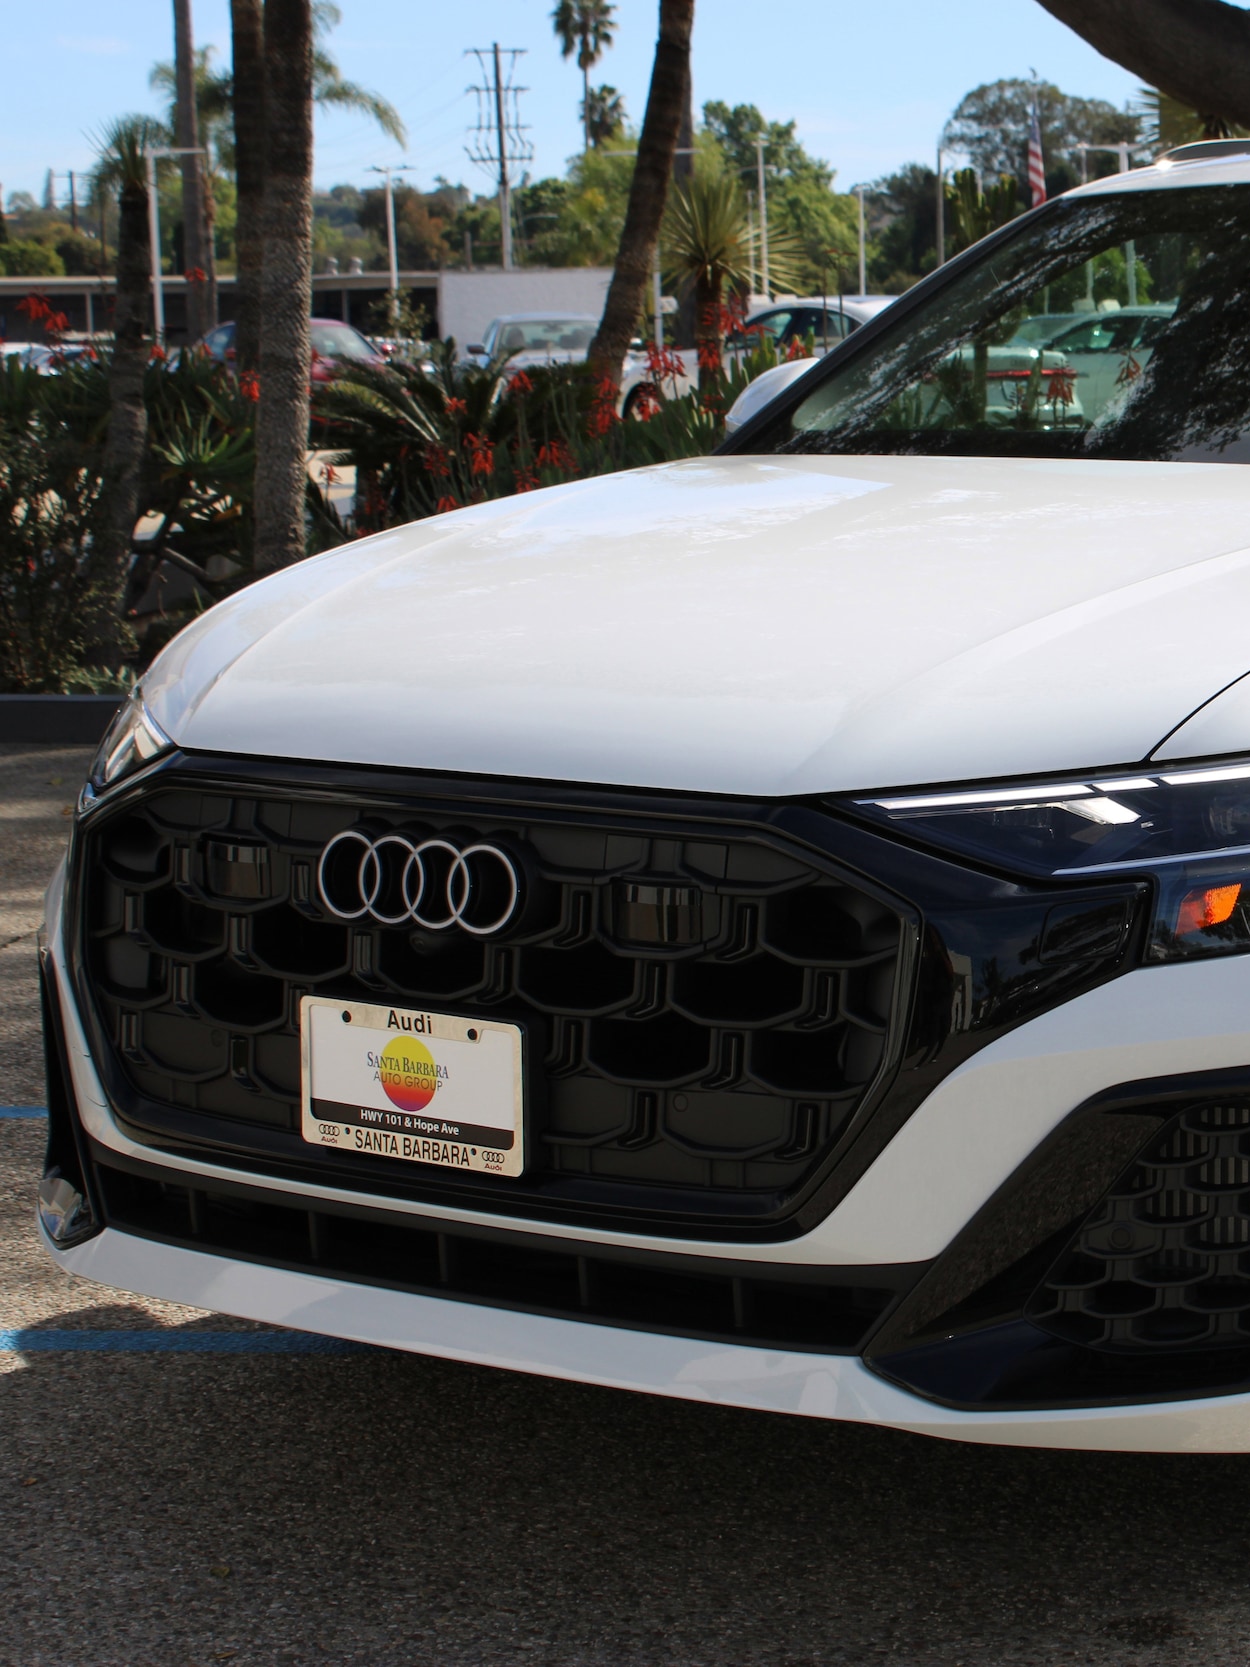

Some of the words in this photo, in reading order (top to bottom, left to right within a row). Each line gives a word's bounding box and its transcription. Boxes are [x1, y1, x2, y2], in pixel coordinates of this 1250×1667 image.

[387, 1009, 432, 1034] Audi
[373, 1071, 401, 1085] AUTO
[404, 1075, 443, 1091] GROUP
[360, 1109, 383, 1122] HWY
[385, 1113, 402, 1126] 101
[404, 1117, 412, 1128] &
[413, 1118, 439, 1133] Hope
[441, 1122, 460, 1136] Ave
[321, 1135, 338, 1144] Audi
[355, 1129, 399, 1155] SANTA
[403, 1137, 470, 1166] BARBARA
[484, 1163, 503, 1171] Audi
